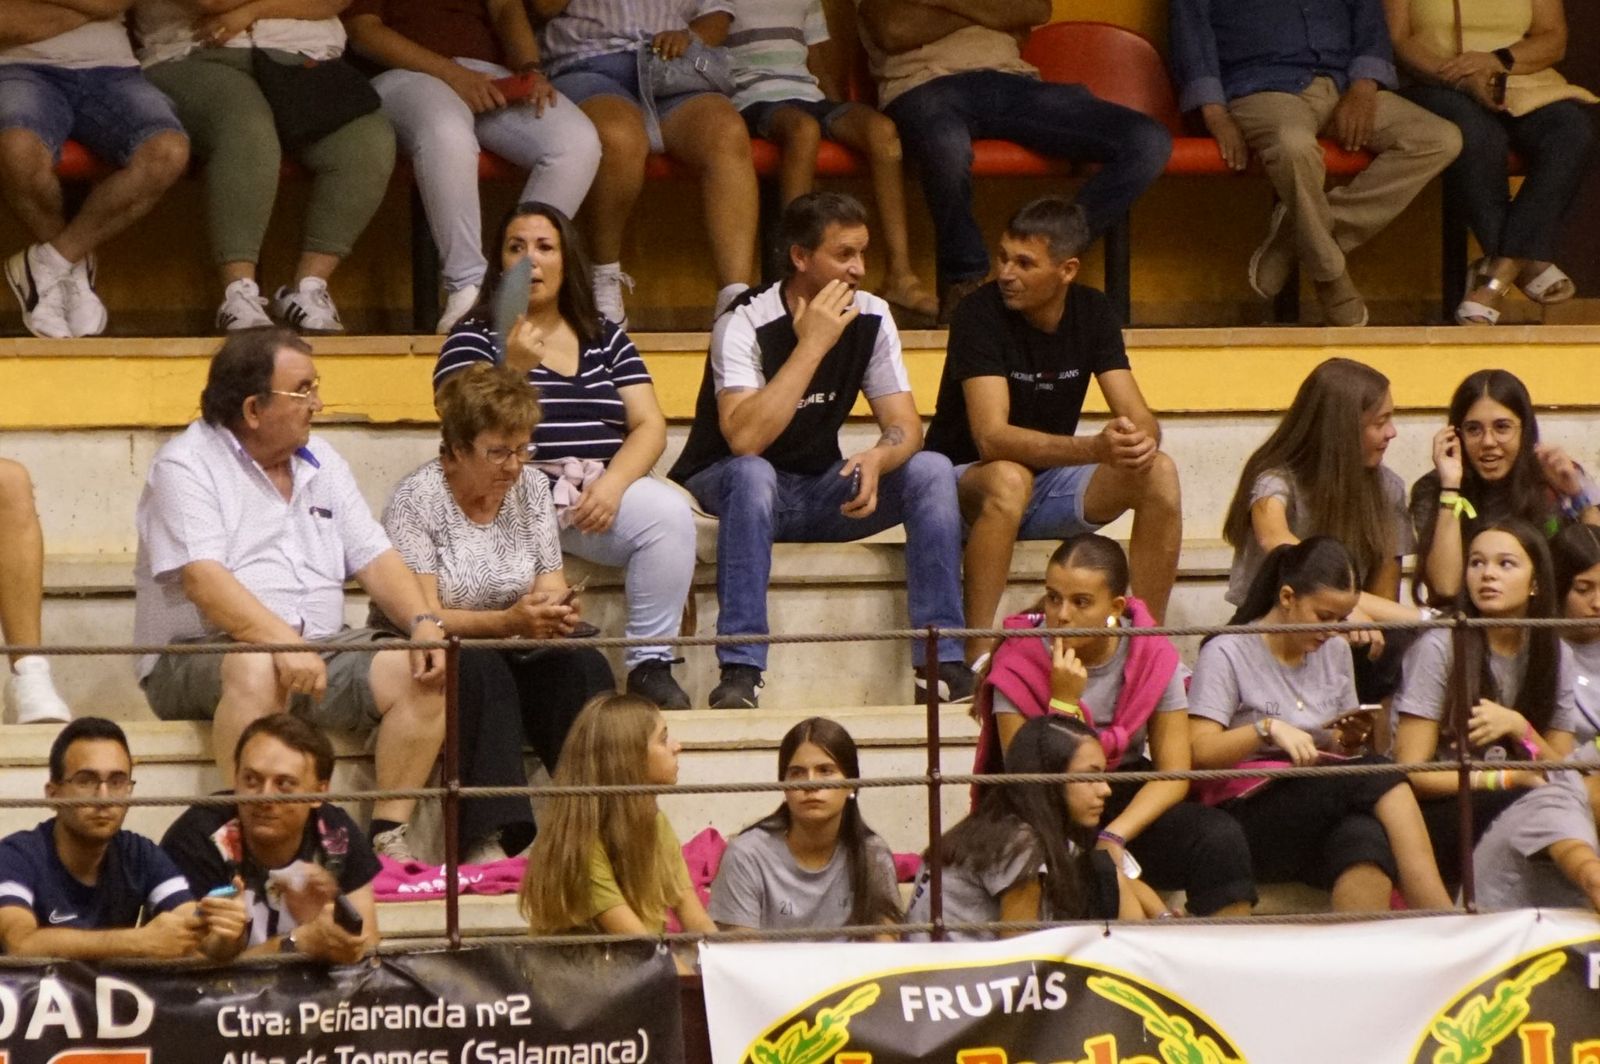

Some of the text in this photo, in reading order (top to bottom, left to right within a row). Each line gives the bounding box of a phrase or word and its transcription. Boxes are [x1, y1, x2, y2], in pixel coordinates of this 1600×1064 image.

[216, 1005, 292, 1038] Ctra:
[298, 996, 467, 1036] Peñaranda
[900, 971, 1068, 1022] FRUTAS
